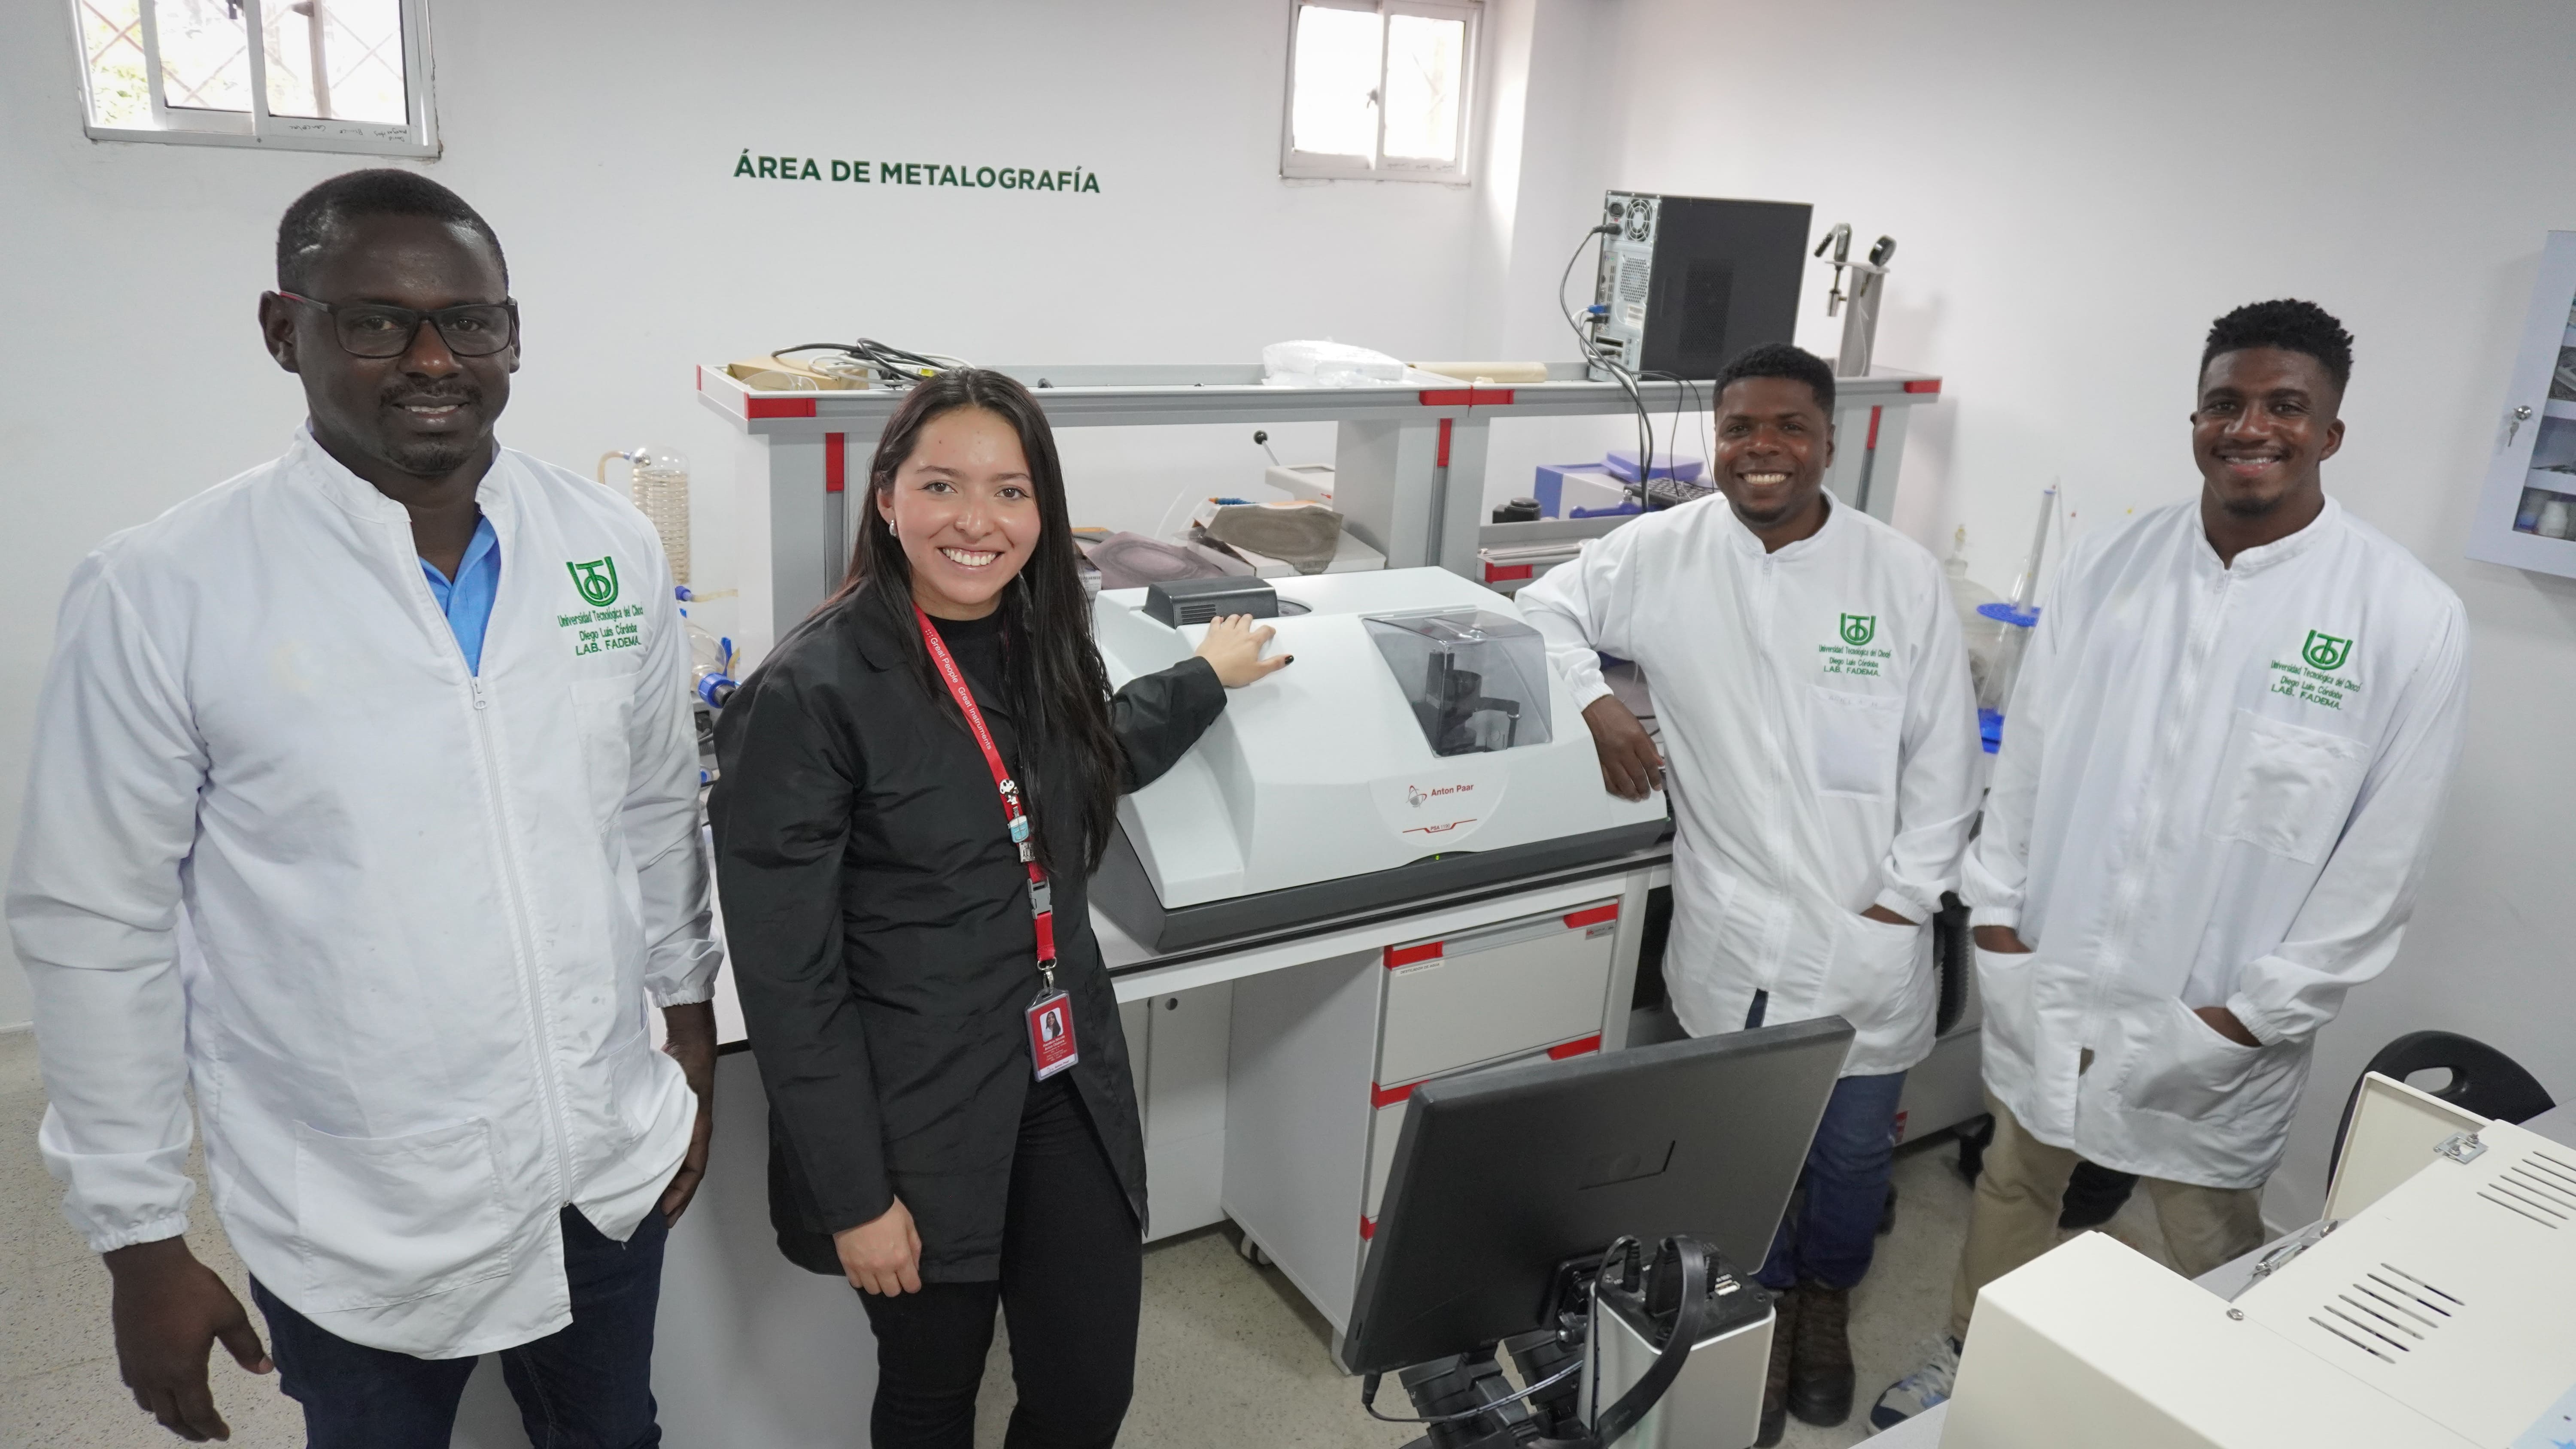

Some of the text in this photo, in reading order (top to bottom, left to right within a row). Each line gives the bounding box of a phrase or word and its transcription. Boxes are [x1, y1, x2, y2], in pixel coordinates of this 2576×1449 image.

[733, 149, 1100, 193] ÁREA DE METALOGRAFÍA
[558, 612, 592, 627] Universidad
[592, 606, 623, 622] Tecnológica
[579, 623, 638, 642] Diego Luis Córdoba
[575, 643, 602, 656] LAB.
[1819, 645, 1844, 653] Universidad
[1846, 646, 1869, 657] Tecnológica
[1829, 657, 1844, 666] Diego
[1858, 658, 1878, 668] Córdoba
[2271, 660, 2302, 674] Universidad
[2304, 667, 2334, 684] Tecnológica
[931, 637, 991, 750] Great People Great Instruments
[2271, 684, 2295, 696] LAB.
[2281, 676, 2342, 698] Diego Luis Córdoba
[1431, 784, 1474, 796] Anton Paar
